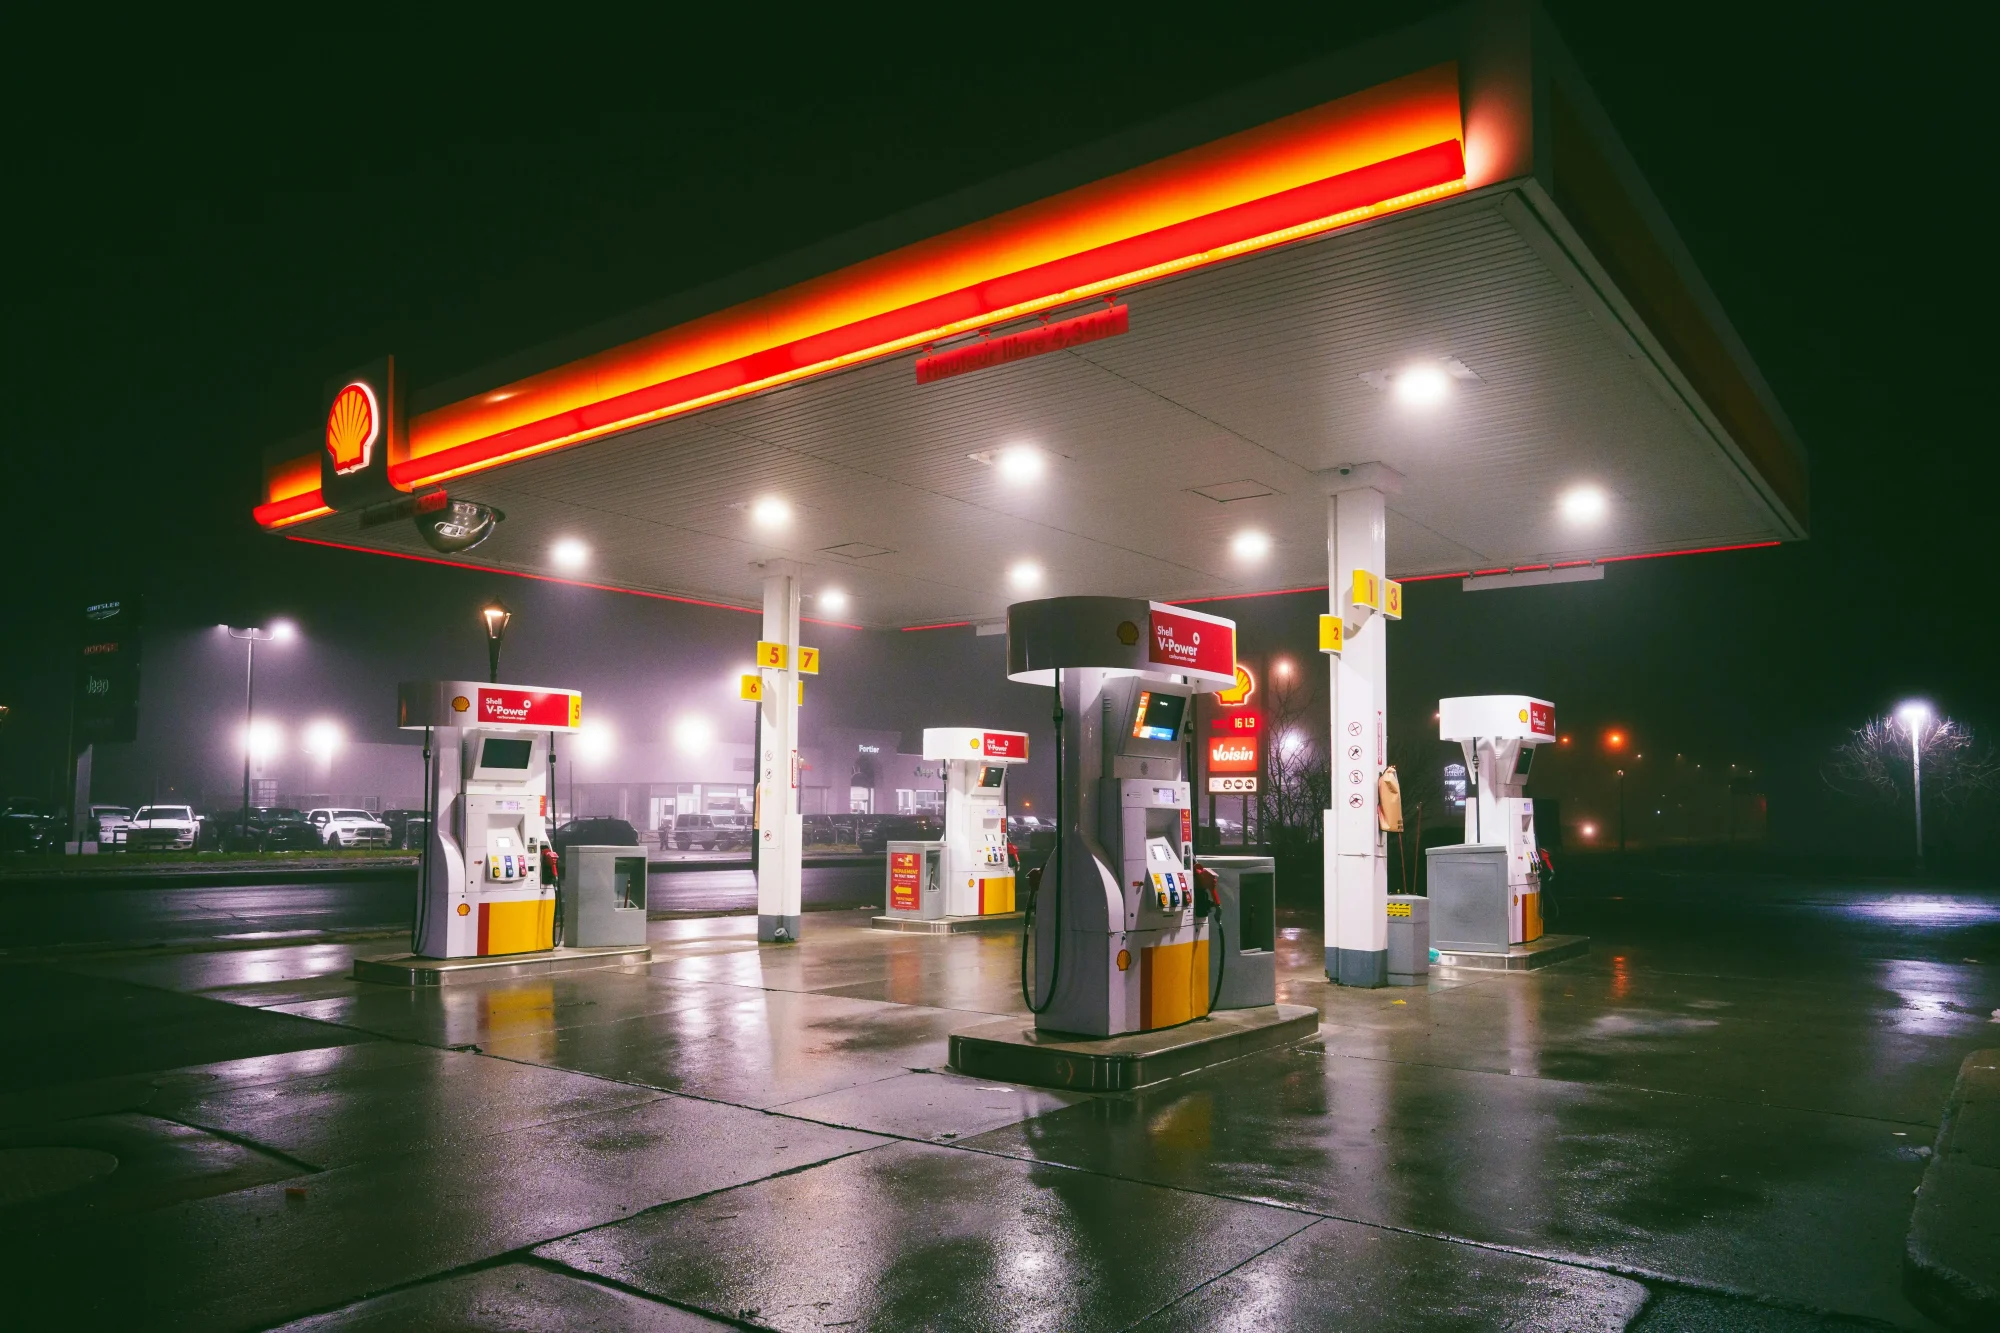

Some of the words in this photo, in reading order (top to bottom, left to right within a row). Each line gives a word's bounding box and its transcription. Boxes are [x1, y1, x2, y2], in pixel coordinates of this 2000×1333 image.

[926, 351, 994, 379] Hauteur
[1002, 337, 1045, 361] libre
[1369, 579, 1374, 602] 1
[1390, 588, 1397, 611] 3
[1157, 626, 1173, 637] Shell
[1333, 627, 1339, 640] 2
[1158, 637, 1198, 656] V-Power
[770, 647, 779, 664] 5
[803, 652, 813, 668] 7
[86, 675, 109, 697] Jeep
[750, 684, 757, 693] 6
[485, 697, 503, 706] Shell
[486, 705, 528, 717] V-Power
[574, 704, 580, 720] 5
[858, 744, 880, 753] Fortier
[1212, 743, 1254, 761] Voisin
